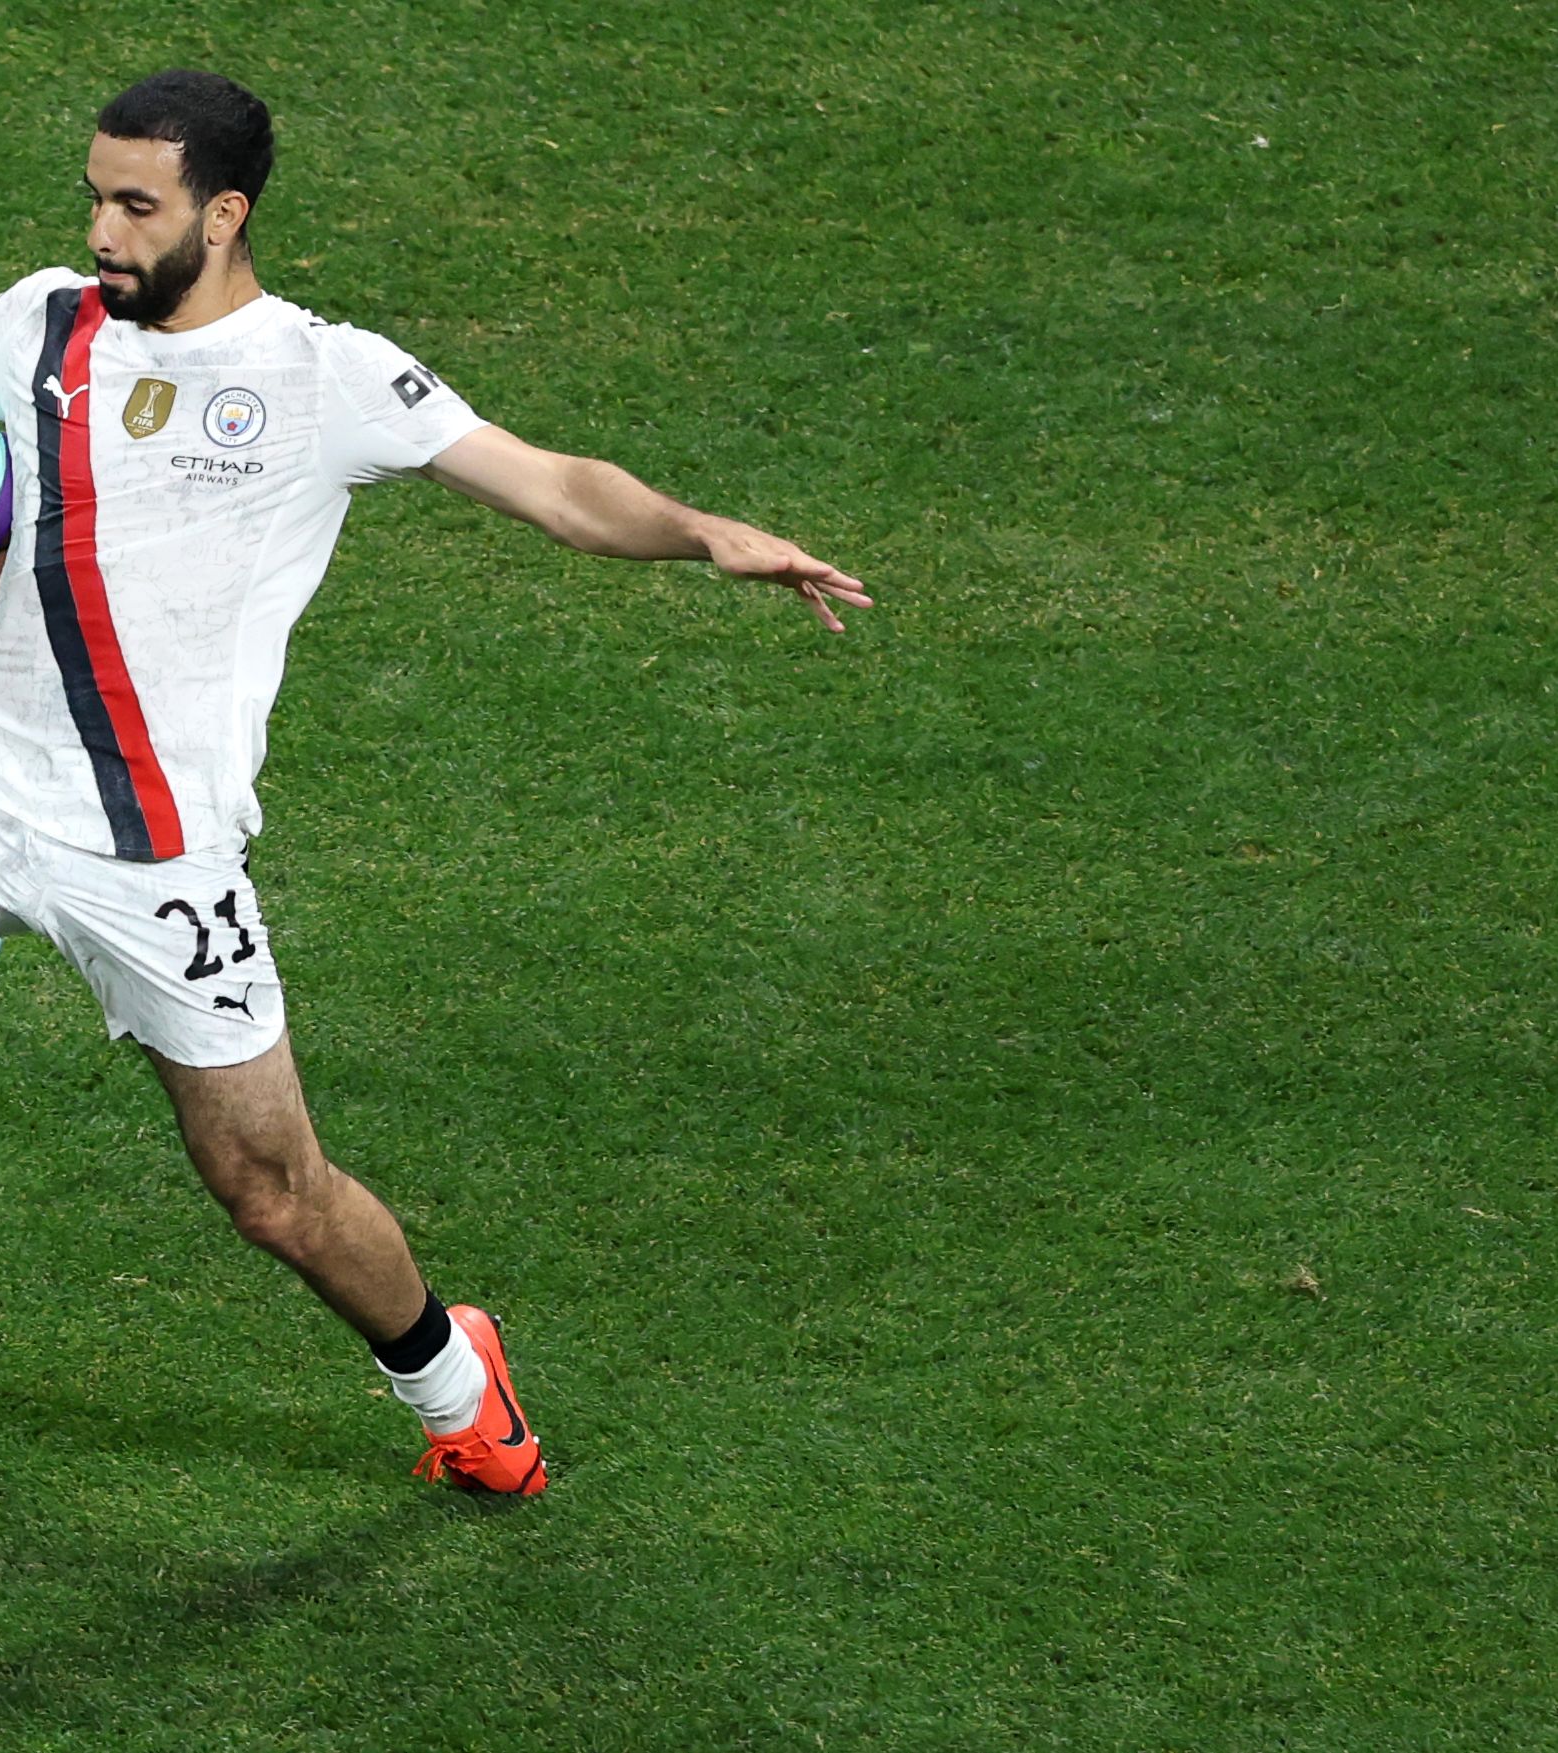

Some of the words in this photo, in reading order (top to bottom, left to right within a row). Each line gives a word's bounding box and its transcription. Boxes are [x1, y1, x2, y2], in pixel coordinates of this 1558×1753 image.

[132, 415, 154, 428] FIFA
[219, 435, 238, 444] CITY
[171, 455, 264, 475] ETIHAD
[185, 473, 239, 486] AIRWAYS
[154, 889, 256, 981] 21
